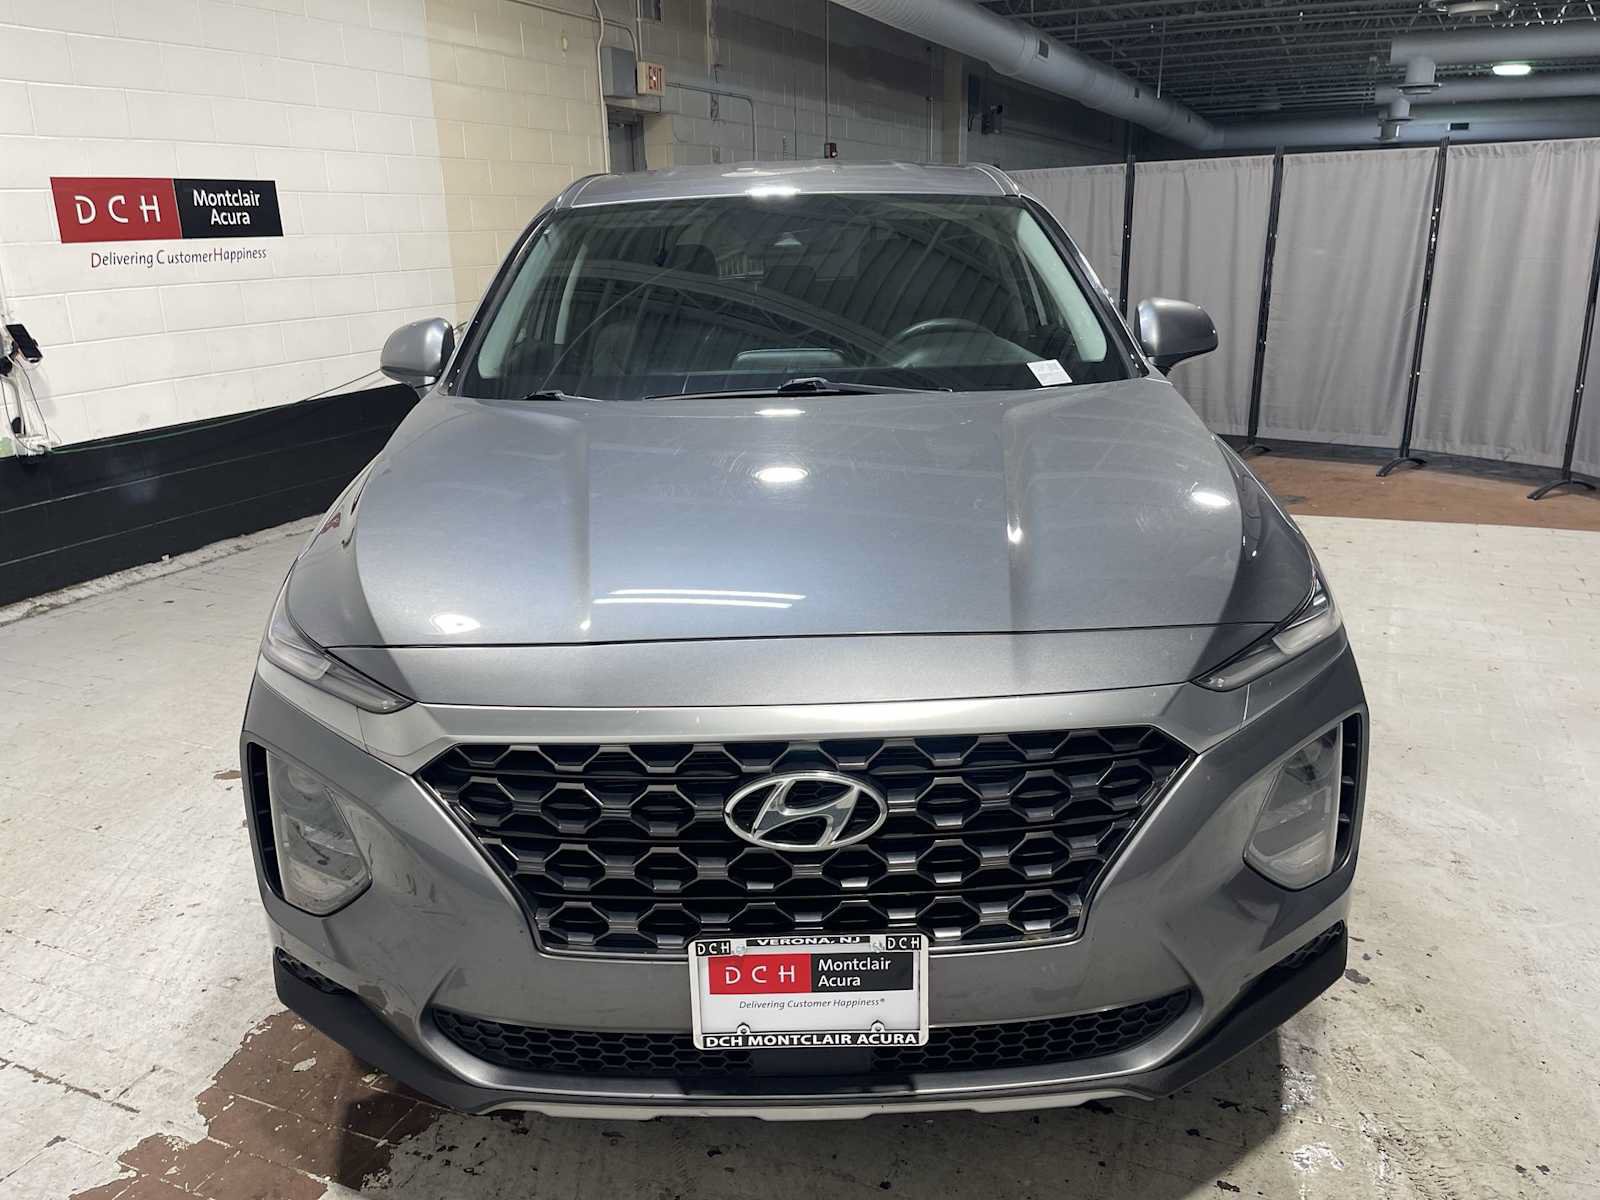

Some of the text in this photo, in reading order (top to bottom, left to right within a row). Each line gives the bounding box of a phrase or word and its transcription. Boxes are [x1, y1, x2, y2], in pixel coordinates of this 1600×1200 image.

[648, 64, 663, 90] EXIT
[193, 189, 261, 207] Montclair
[74, 194, 161, 225] DCH
[211, 209, 251, 226] Acura
[91, 250, 154, 269] Delivering
[757, 936, 861, 946] VERONA, NJ
[888, 937, 920, 950] DCH
[697, 943, 730, 956] DCH
[818, 957, 891, 972] Montclair
[724, 965, 796, 985] DCH
[818, 974, 861, 988] Acura
[739, 1000, 785, 1011] Delivering
[787, 998, 832, 1009] Customer
[706, 1033, 918, 1048] DCH MONTCLAIR ACURA
